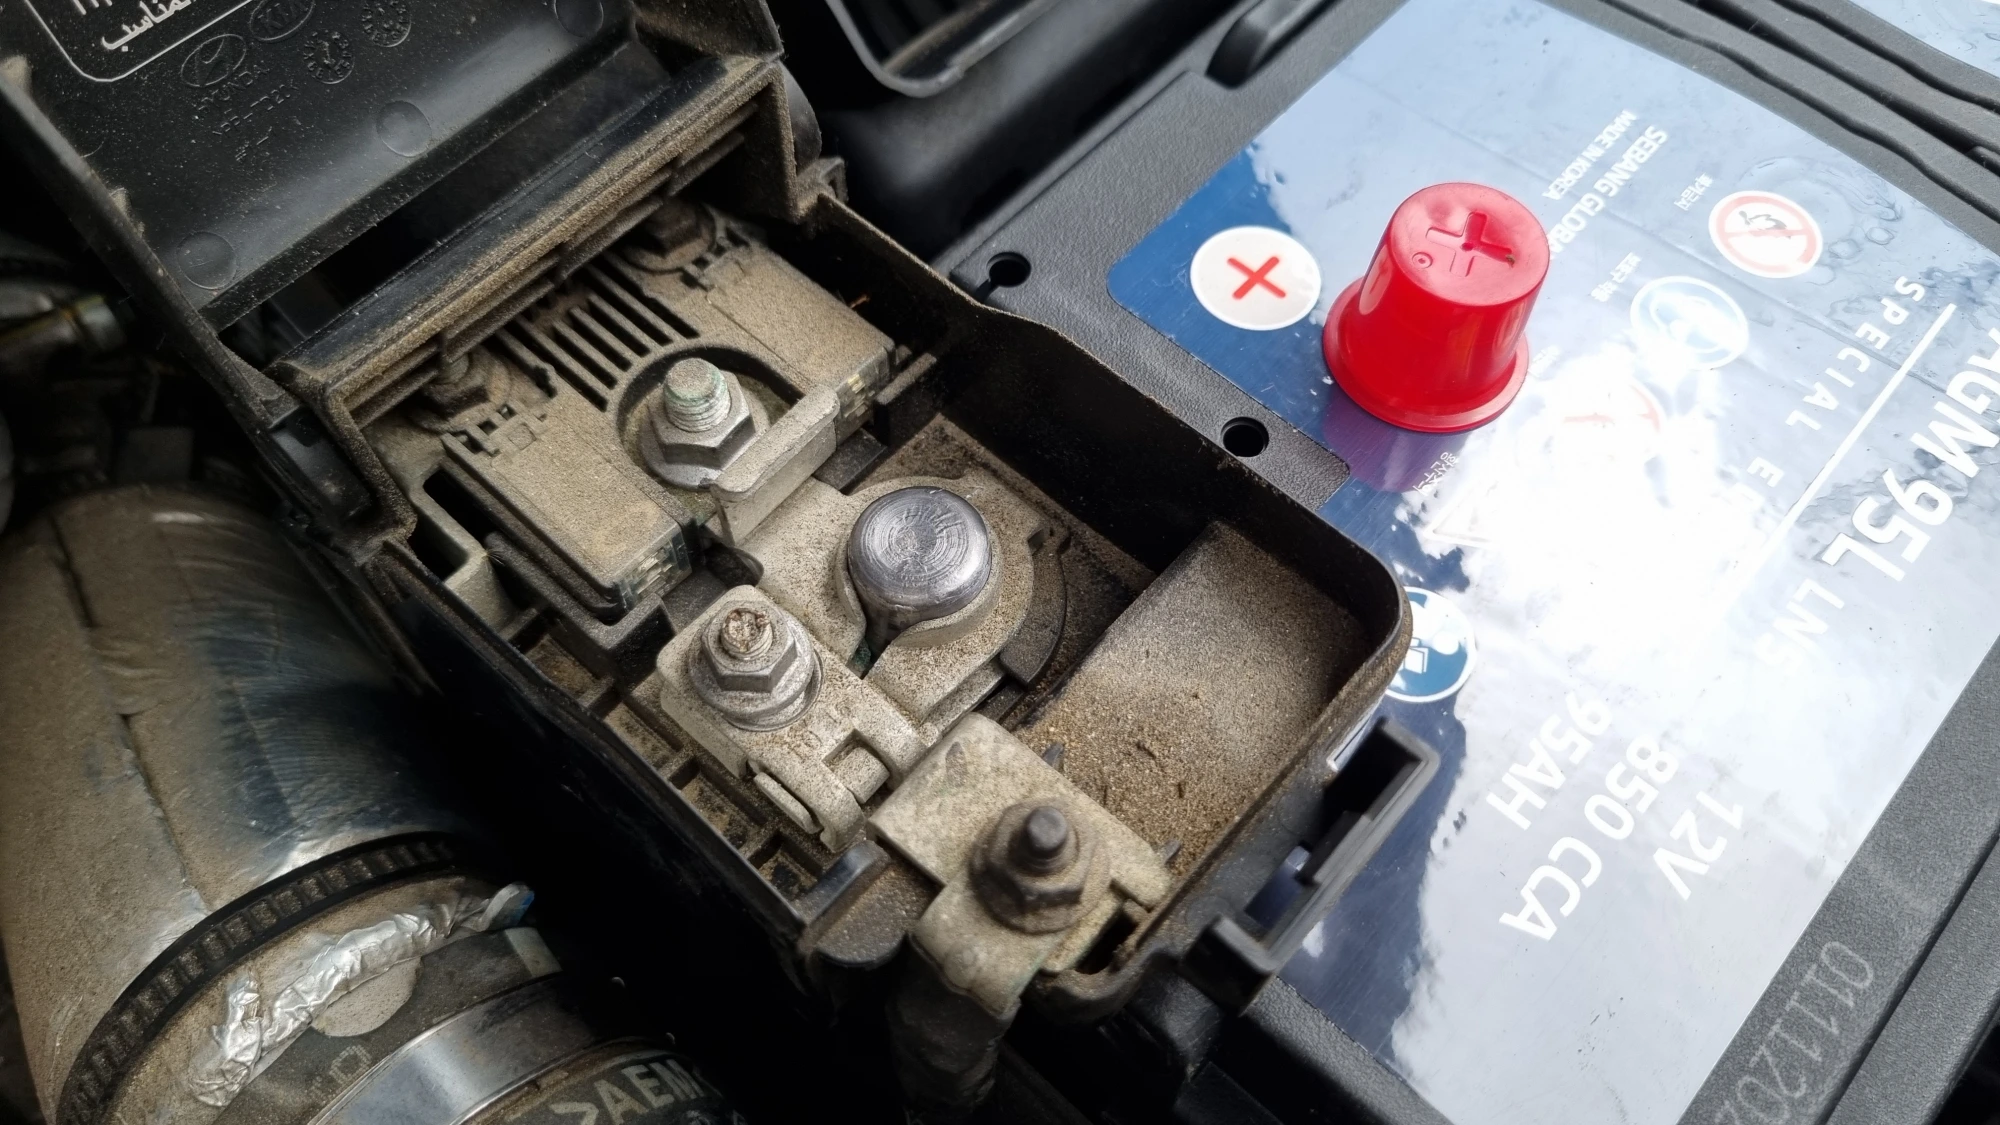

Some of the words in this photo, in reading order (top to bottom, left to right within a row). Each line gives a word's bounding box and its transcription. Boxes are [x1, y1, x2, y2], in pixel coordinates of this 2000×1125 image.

[1542, 154, 1592, 200] KOREA
[1581, 143, 1605, 162] IN
[1593, 125, 1668, 197] SEBANG
[1594, 109, 1638, 149] MADE
[1548, 192, 1606, 259] GLOBA
[1785, 276, 1926, 431] SPECIAL
[1821, 467, 1954, 582] 95L
[1486, 691, 1612, 831] 95AH
[1584, 734, 1679, 841] 850
[1499, 836, 1603, 941] CCA
[1652, 791, 1744, 901] 12V
